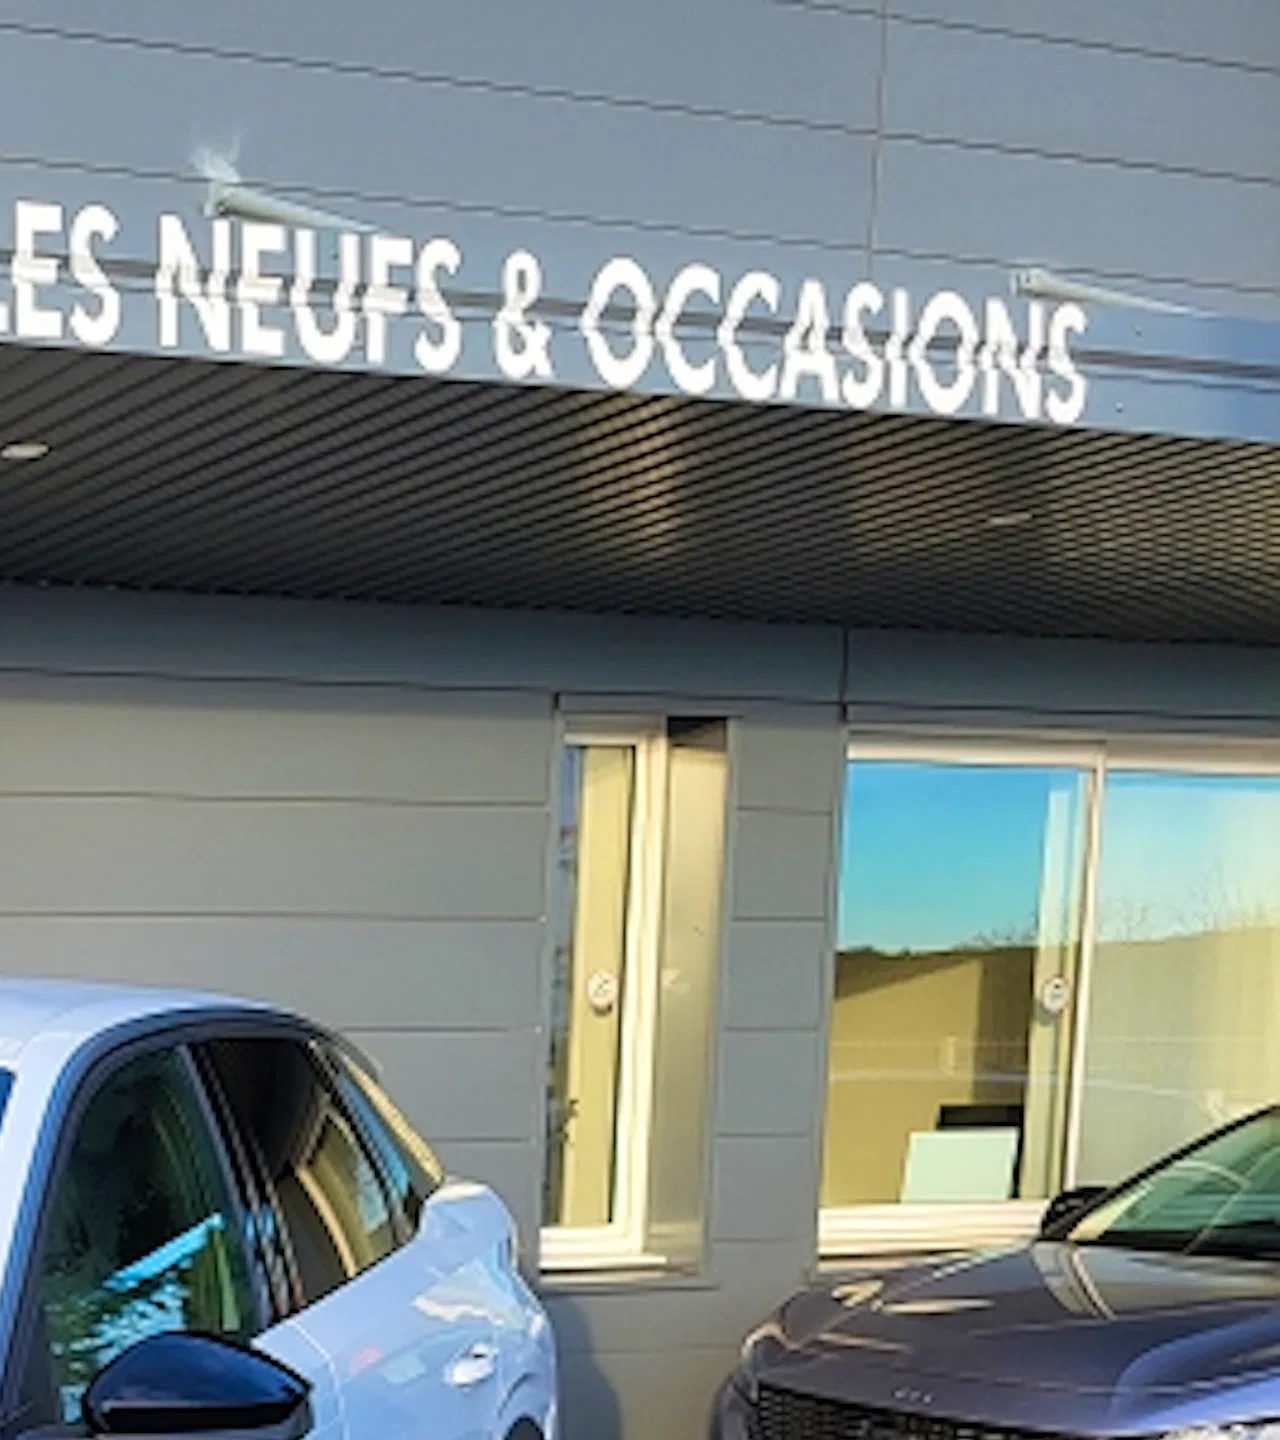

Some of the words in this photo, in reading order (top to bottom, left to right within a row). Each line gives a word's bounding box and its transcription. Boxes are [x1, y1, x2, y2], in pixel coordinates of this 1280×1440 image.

[156, 212, 463, 373] NEUFS
[494, 250, 552, 380] &
[582, 256, 1086, 425] OCCASIONS
